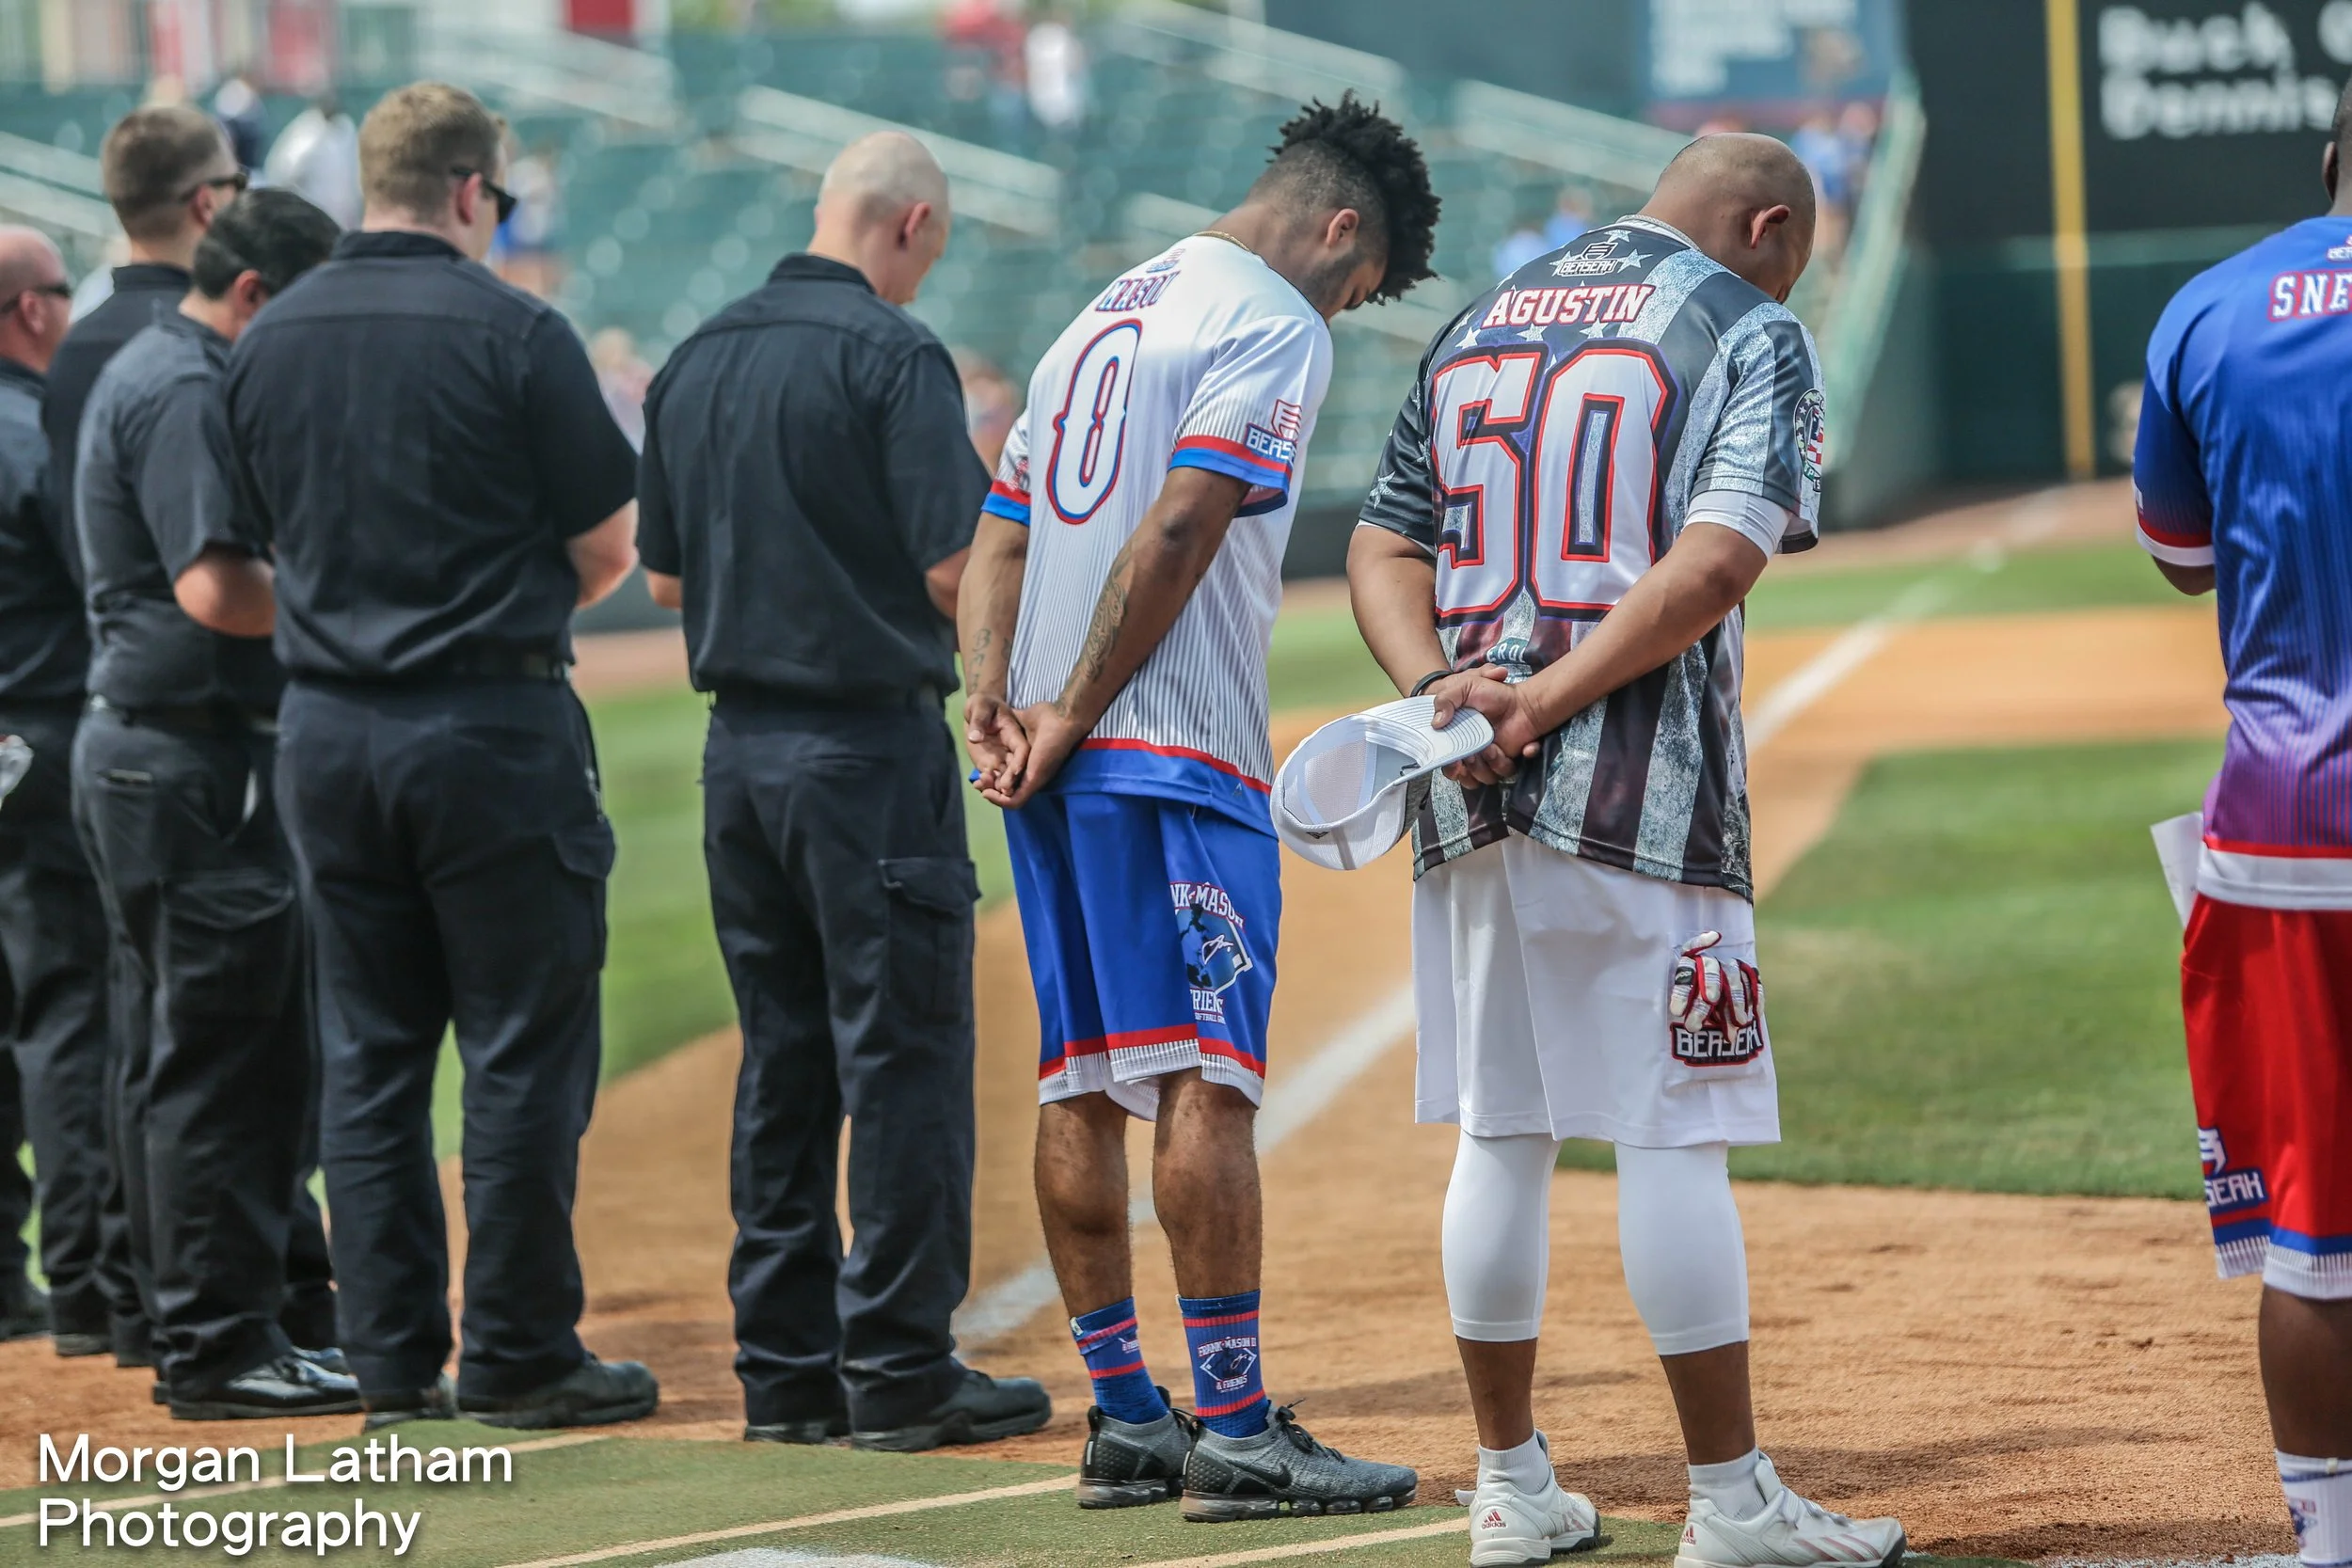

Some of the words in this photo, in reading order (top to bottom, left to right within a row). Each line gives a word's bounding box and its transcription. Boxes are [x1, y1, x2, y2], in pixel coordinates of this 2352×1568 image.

[2099, 77, 2341, 139] Dennis
[1481, 284, 1657, 328] AGUSTIN
[1046, 318, 1143, 525] 0
[1431, 340, 1677, 626] 50
[1481, 1521, 1507, 1529] adidas
